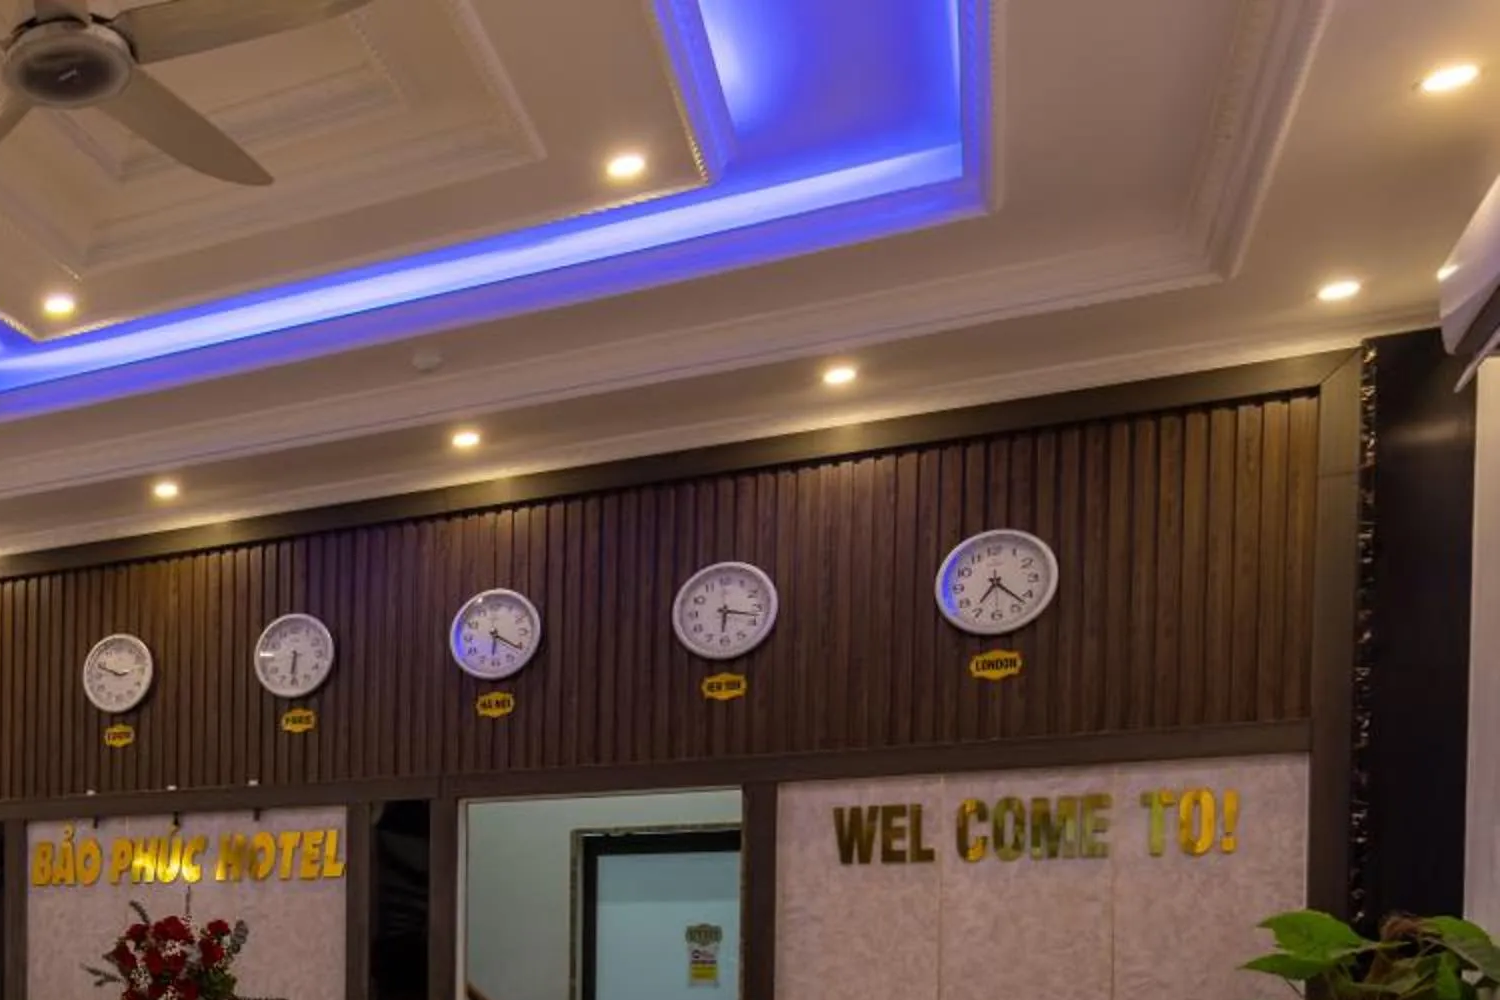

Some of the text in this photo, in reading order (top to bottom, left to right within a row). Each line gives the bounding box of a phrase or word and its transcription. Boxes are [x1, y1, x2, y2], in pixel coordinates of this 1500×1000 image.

[975, 657, 1017, 672] LONDON
[32, 824, 345, 886] BẢO PHÚC HOTEL
[833, 786, 1240, 865] WEL COME TO!
